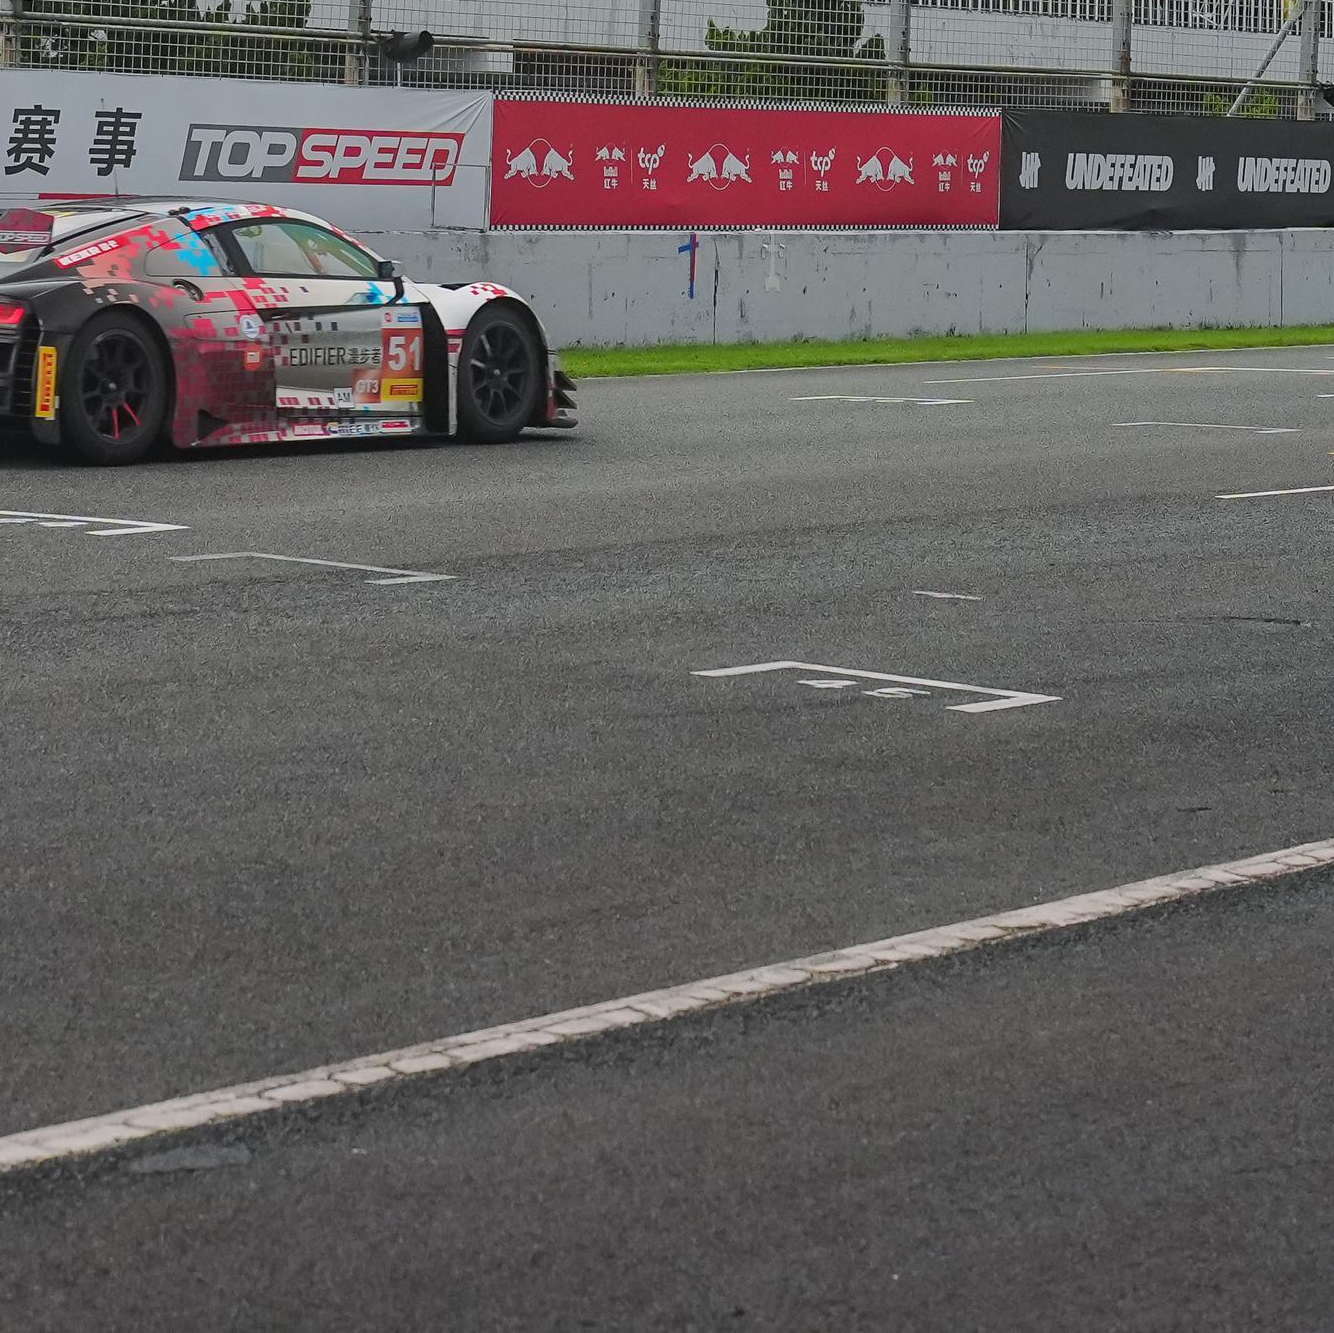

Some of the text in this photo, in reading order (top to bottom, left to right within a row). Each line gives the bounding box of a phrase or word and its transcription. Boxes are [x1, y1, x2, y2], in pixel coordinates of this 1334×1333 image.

[1066, 153, 1174, 191] UNDEFEATED
[1237, 157, 1331, 193] UNDEFEATED
[290, 348, 346, 366] EDIFIER
[388, 336, 420, 371] 51
[355, 379, 380, 394] GT3
